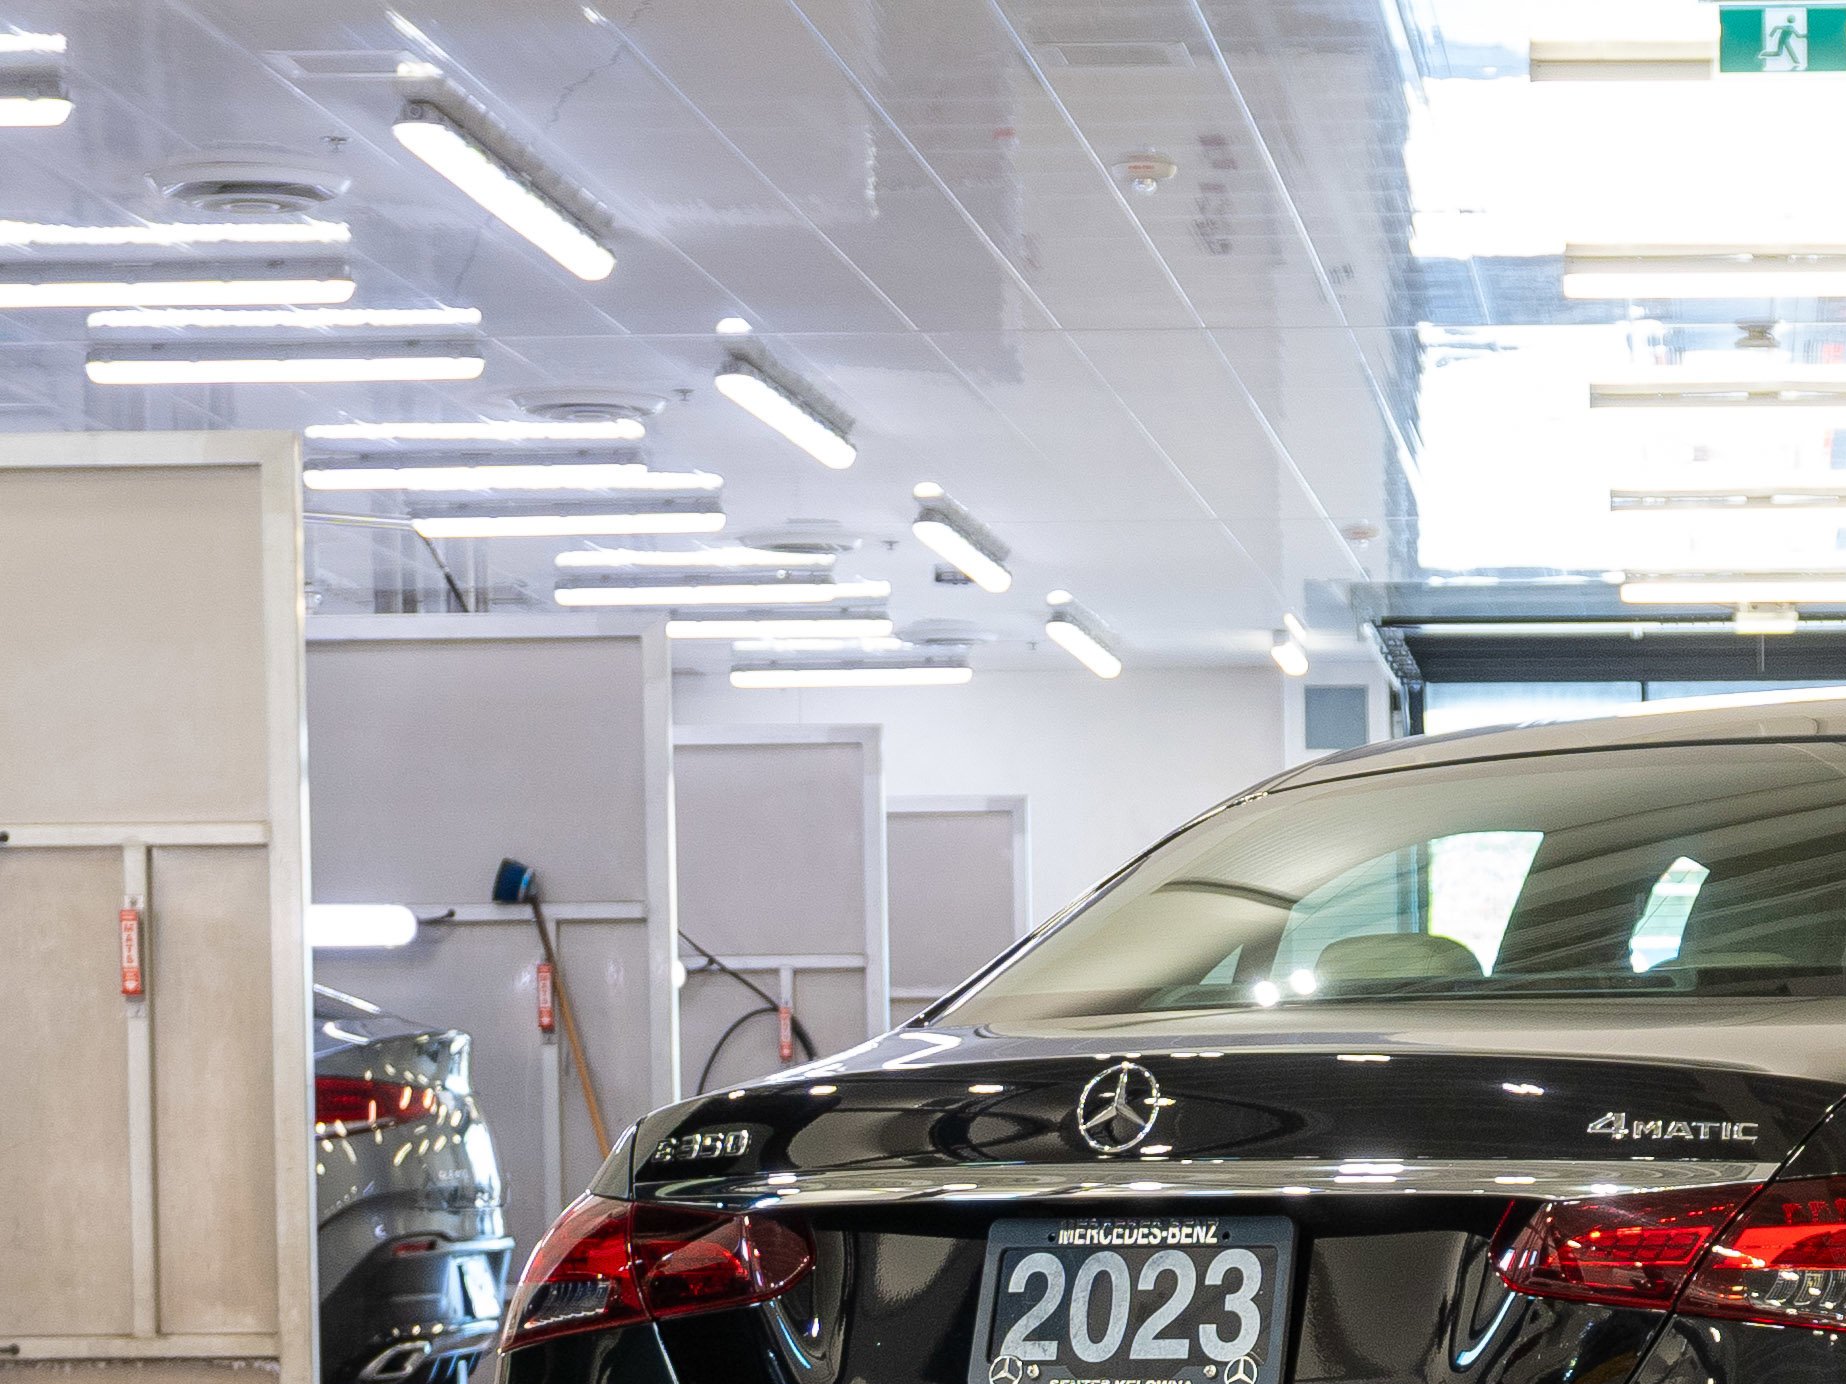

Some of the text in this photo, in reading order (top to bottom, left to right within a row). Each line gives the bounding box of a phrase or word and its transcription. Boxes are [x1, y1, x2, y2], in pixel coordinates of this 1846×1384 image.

[1587, 1112, 1759, 1140] 4MATIC
[1057, 1220, 1220, 1245] MERCEDES-BENZ
[999, 1248, 1263, 1364] 2023
